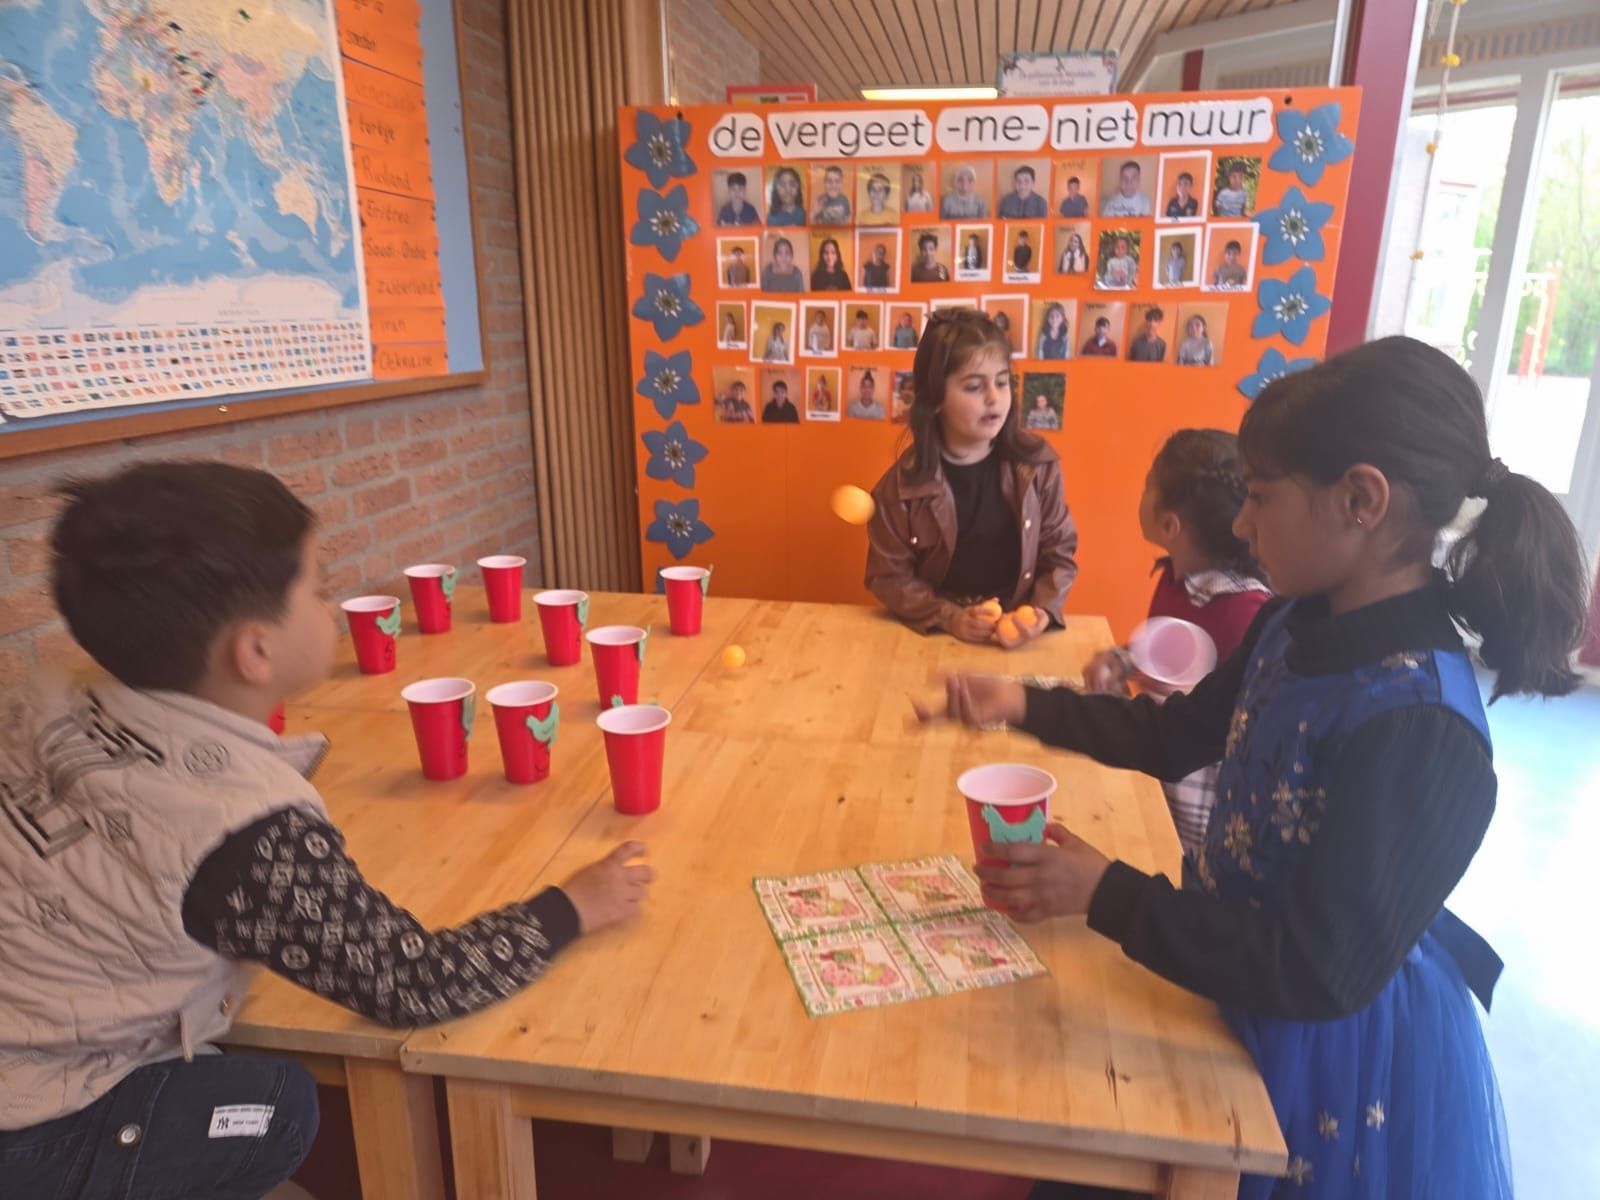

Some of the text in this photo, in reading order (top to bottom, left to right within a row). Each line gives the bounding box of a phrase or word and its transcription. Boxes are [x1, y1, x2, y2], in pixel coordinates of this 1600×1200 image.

[712, 106, 1267, 157] de vergeet -me- niet muur
